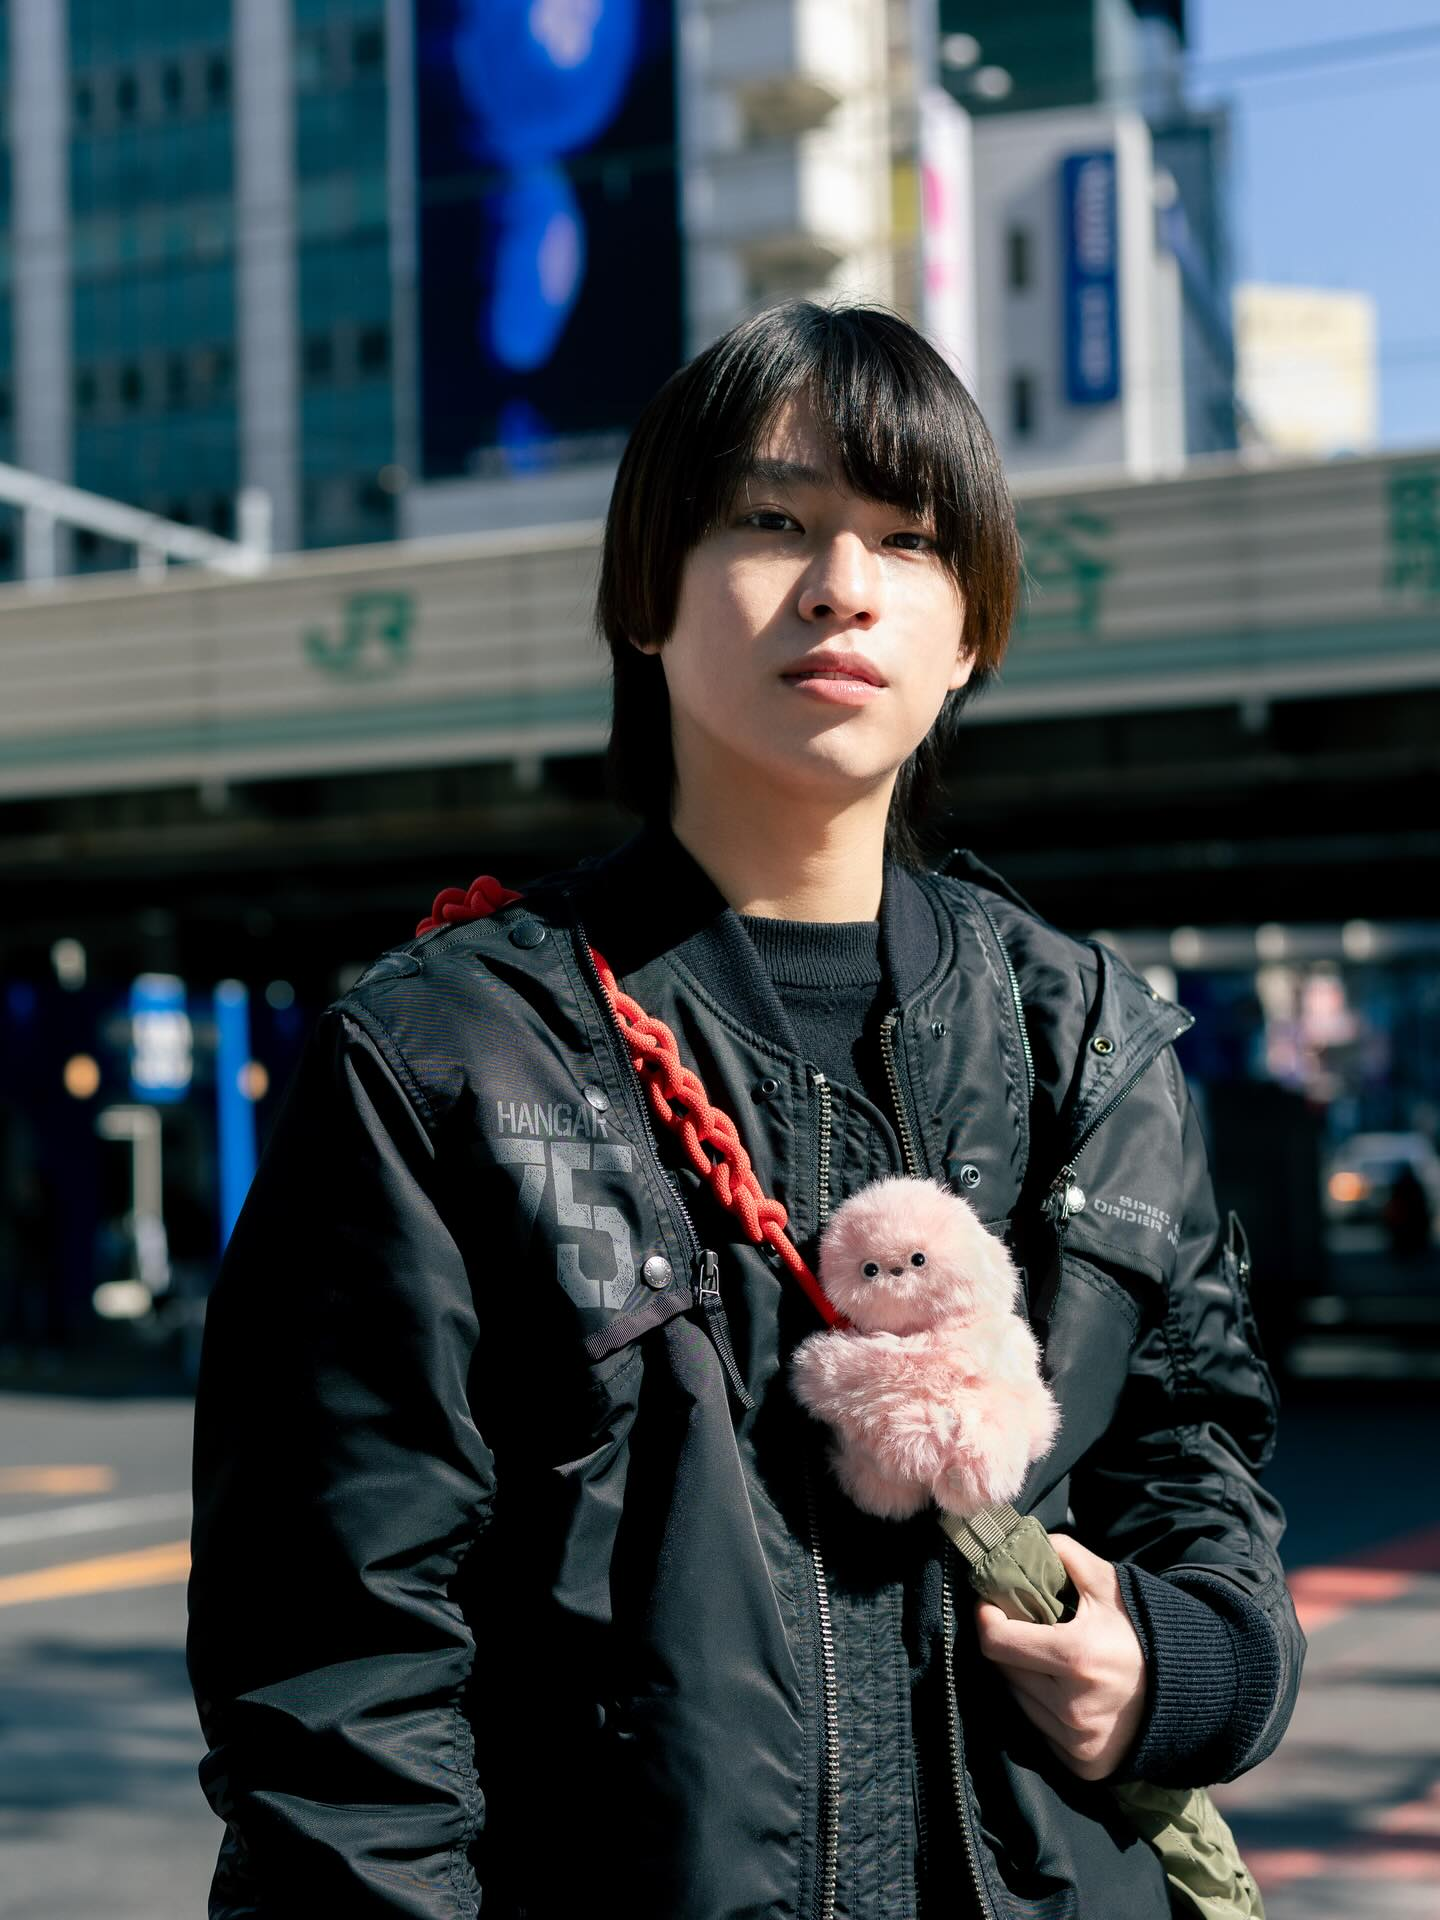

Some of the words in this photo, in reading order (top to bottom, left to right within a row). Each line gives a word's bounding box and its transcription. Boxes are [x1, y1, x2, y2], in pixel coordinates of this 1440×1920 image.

[303, 589, 417, 682] JR
[496, 1101, 609, 1138] HANGAR
[492, 1138, 636, 1311] 75
[1094, 1198, 1163, 1233] ORDER
